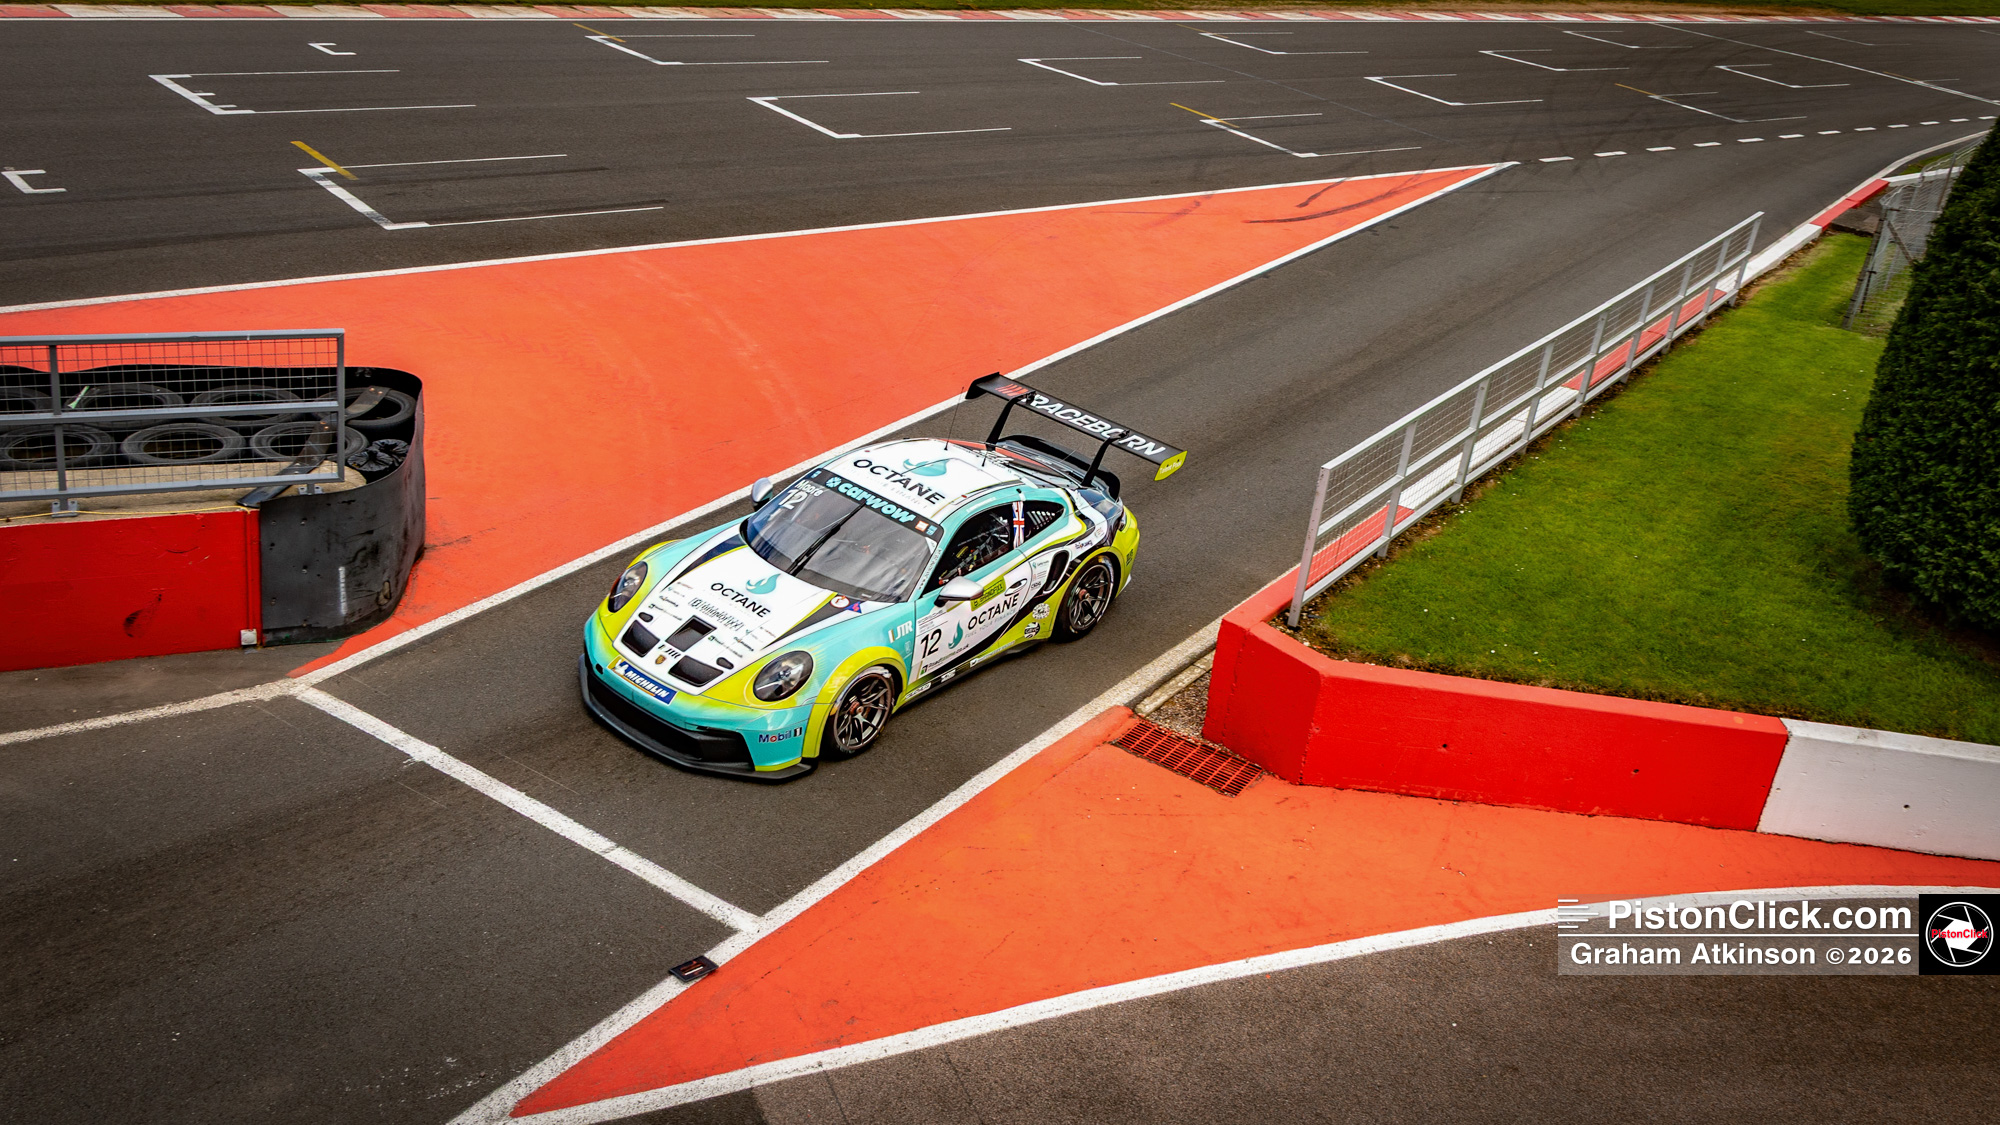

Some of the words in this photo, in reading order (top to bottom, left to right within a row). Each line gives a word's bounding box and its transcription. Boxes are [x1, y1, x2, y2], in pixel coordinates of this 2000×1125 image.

[795, 479, 824, 497] Moore
[853, 459, 946, 505] OCTANE
[779, 488, 808, 511] 12
[838, 482, 917, 524] carwow
[710, 582, 771, 618] OCTANE
[967, 592, 1020, 631] OCTANE
[895, 620, 914, 640] JTR
[920, 628, 942, 659] 12
[624, 670, 670, 698] MICHELIN
[758, 730, 792, 743] Mobil
